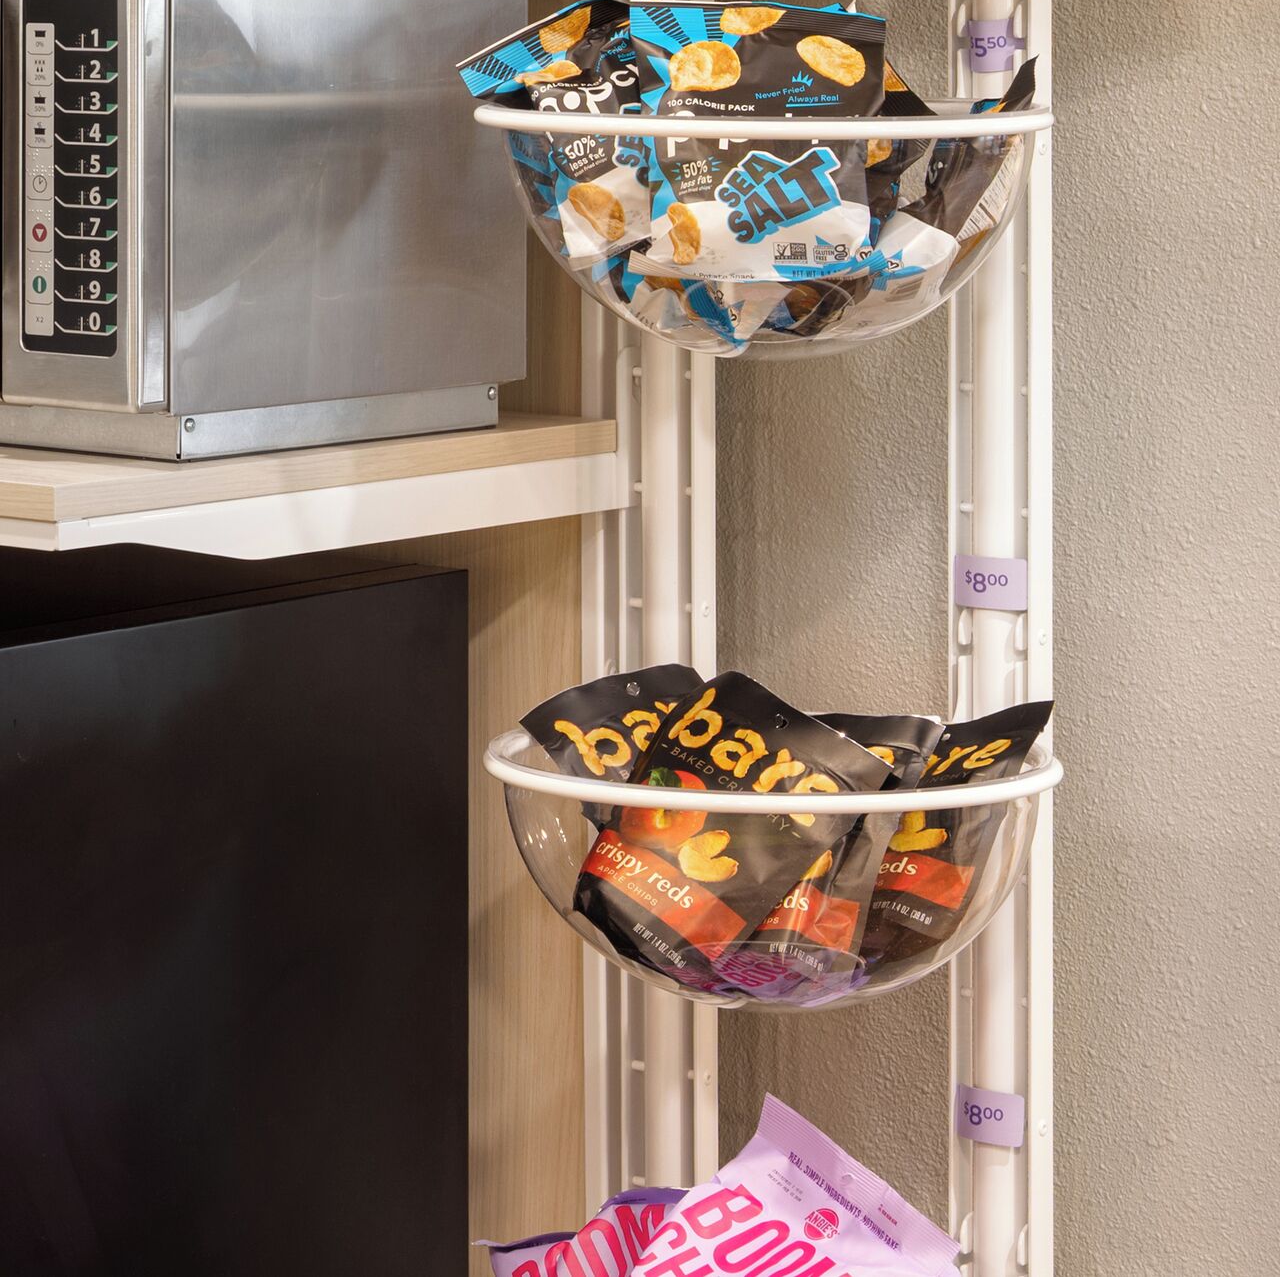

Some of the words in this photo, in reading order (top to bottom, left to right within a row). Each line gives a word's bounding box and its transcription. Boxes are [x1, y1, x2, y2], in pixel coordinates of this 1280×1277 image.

[91, 28, 99, 47] 1
[90, 60, 101, 78] 2
[90, 91, 101, 110] 3
[668, 99, 683, 107] 100
[685, 97, 725, 111] CALORIE
[728, 103, 755, 112] PACK
[89, 123, 101, 141] 4
[90, 155, 100, 173] 5
[717, 154, 781, 209] SEA
[89, 186, 101, 204] 6
[728, 151, 827, 242] SALT
[90, 218, 101, 236] 7
[89, 249, 101, 267] 8
[89, 281, 101, 299] 9
[89, 312, 101, 331] 0
[596, 841, 642, 875] crispy
[648, 871, 695, 909] reds
